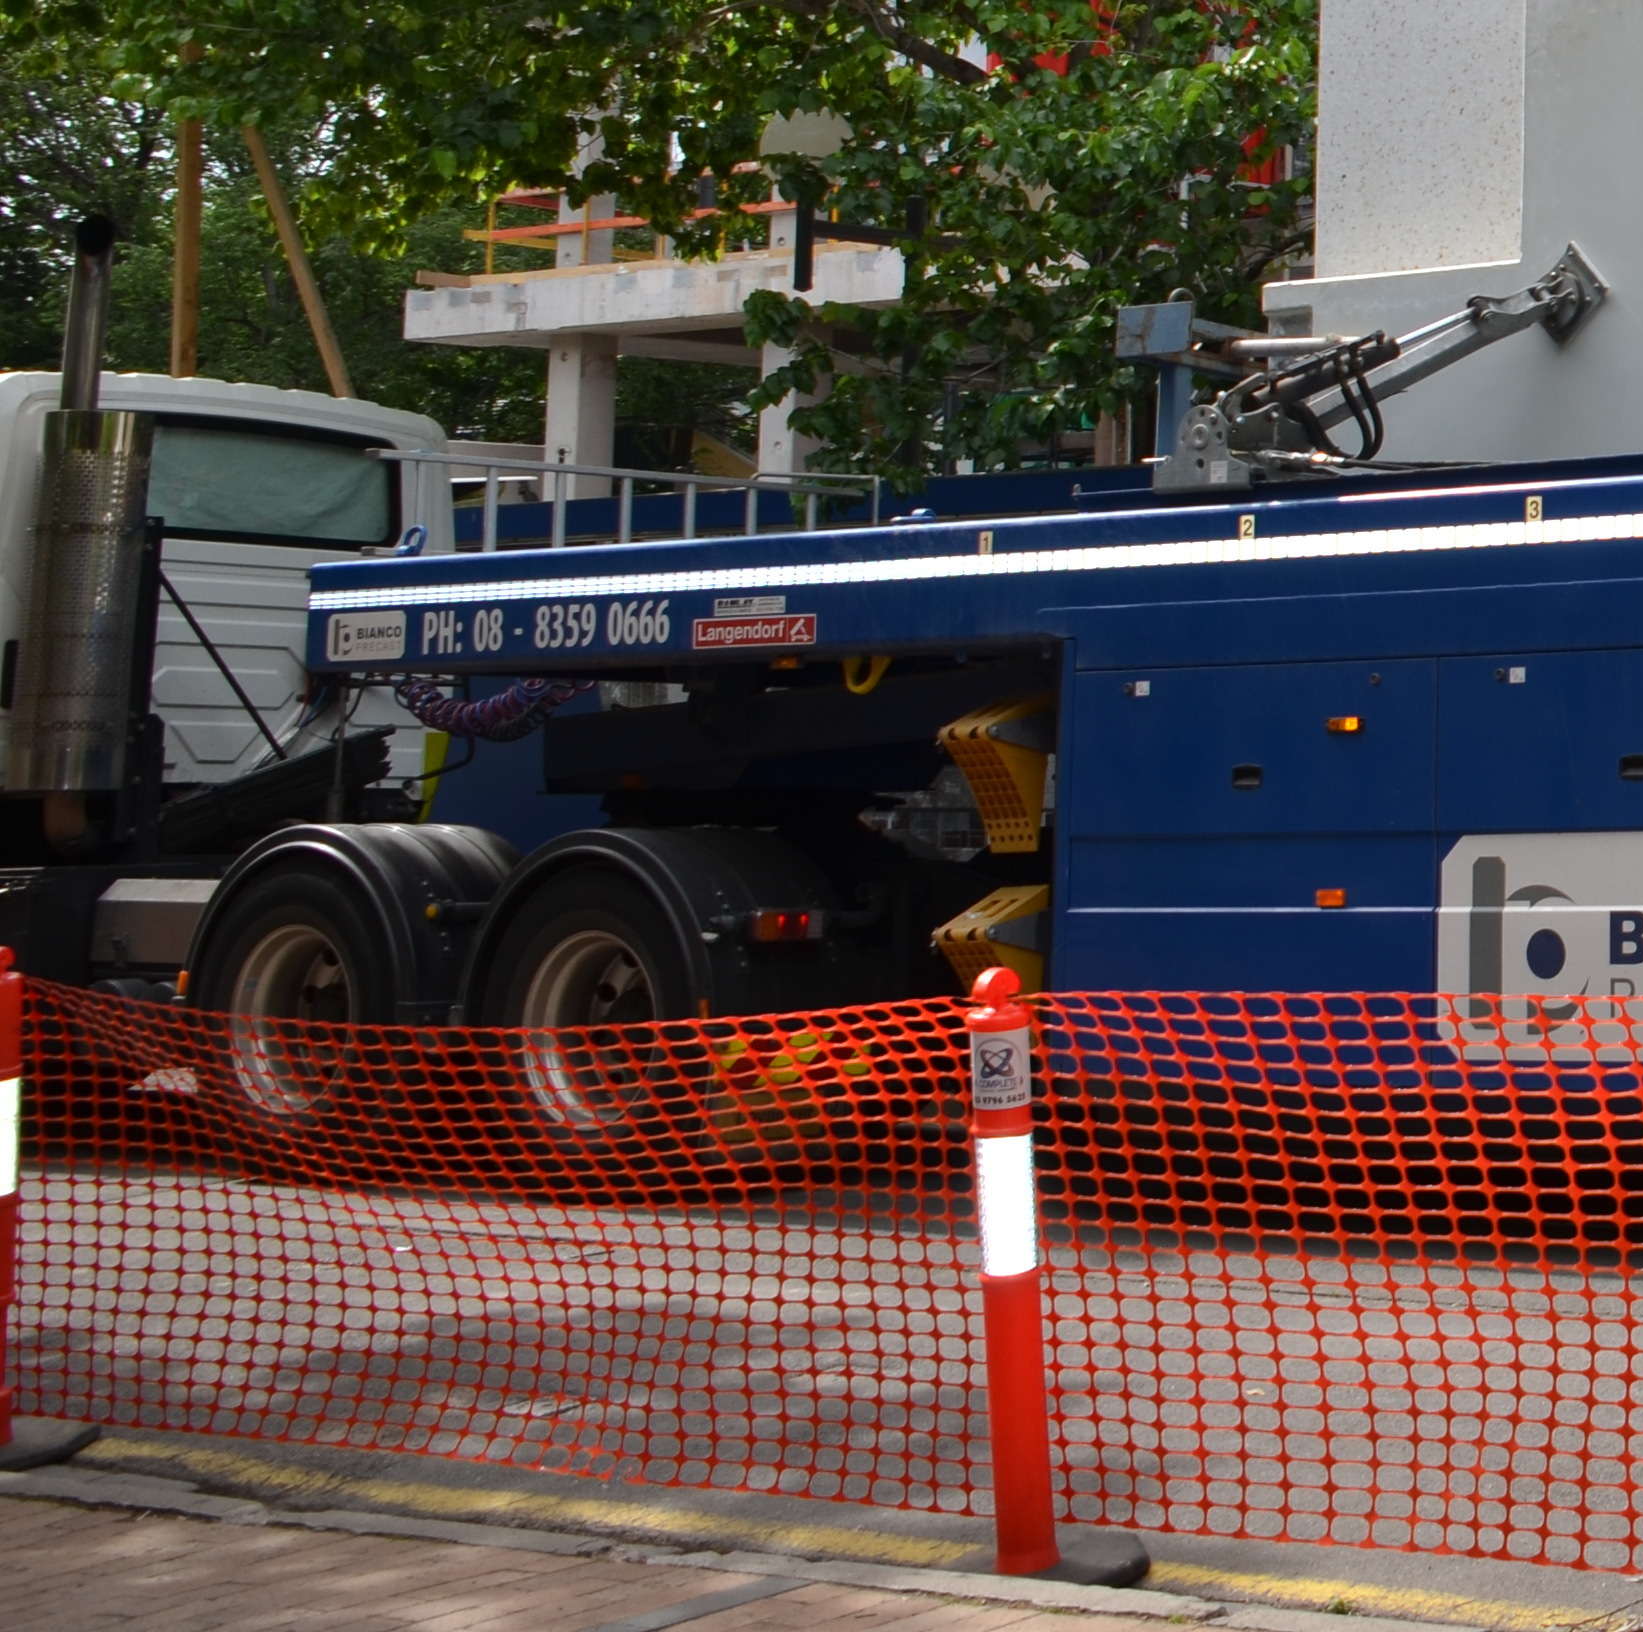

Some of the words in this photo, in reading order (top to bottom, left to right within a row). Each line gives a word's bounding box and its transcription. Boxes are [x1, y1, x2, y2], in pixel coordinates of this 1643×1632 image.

[1528, 499, 1540, 519] 3
[1243, 518, 1253, 537] 2
[983, 534, 990, 552] 1
[356, 625, 402, 640] BIANCO
[422, 610, 464, 655] PH:
[473, 608, 504, 653] 08
[534, 602, 597, 649] 8359
[607, 599, 671, 646] 0666
[697, 619, 785, 644] Langendorf
[355, 640, 402, 652] PRECAST
[979, 1078, 1017, 1088] COMPLETE
[982, 1096, 1003, 1104] 9796
